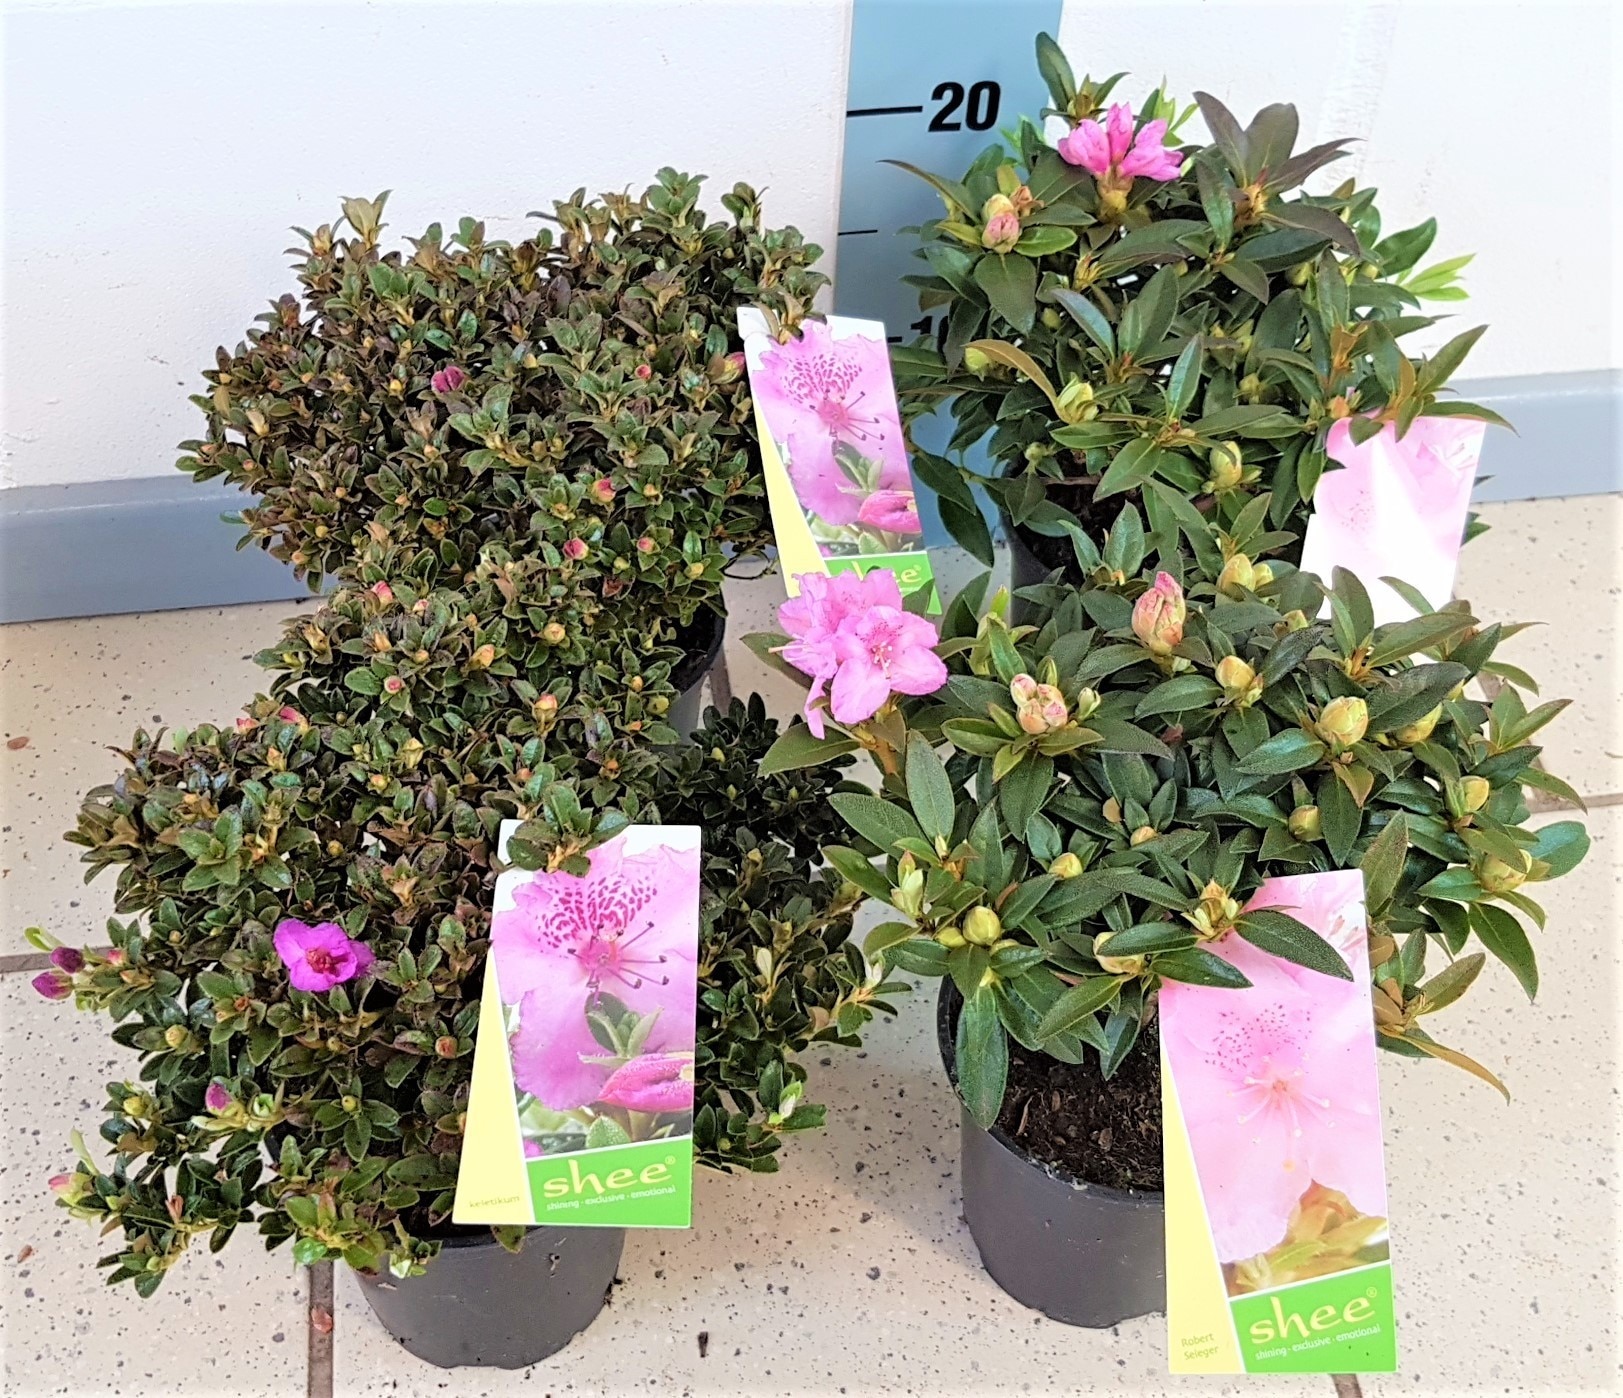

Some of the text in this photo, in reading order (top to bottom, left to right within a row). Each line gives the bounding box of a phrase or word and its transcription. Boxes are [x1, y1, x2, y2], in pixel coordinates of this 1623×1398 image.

[928, 81, 1001, 132] 20
[547, 1185, 676, 1211] shining exclusive emotional
[1181, 1332, 1214, 1347] Robert
[1255, 1323, 1381, 1360] shining exclusive emotional
